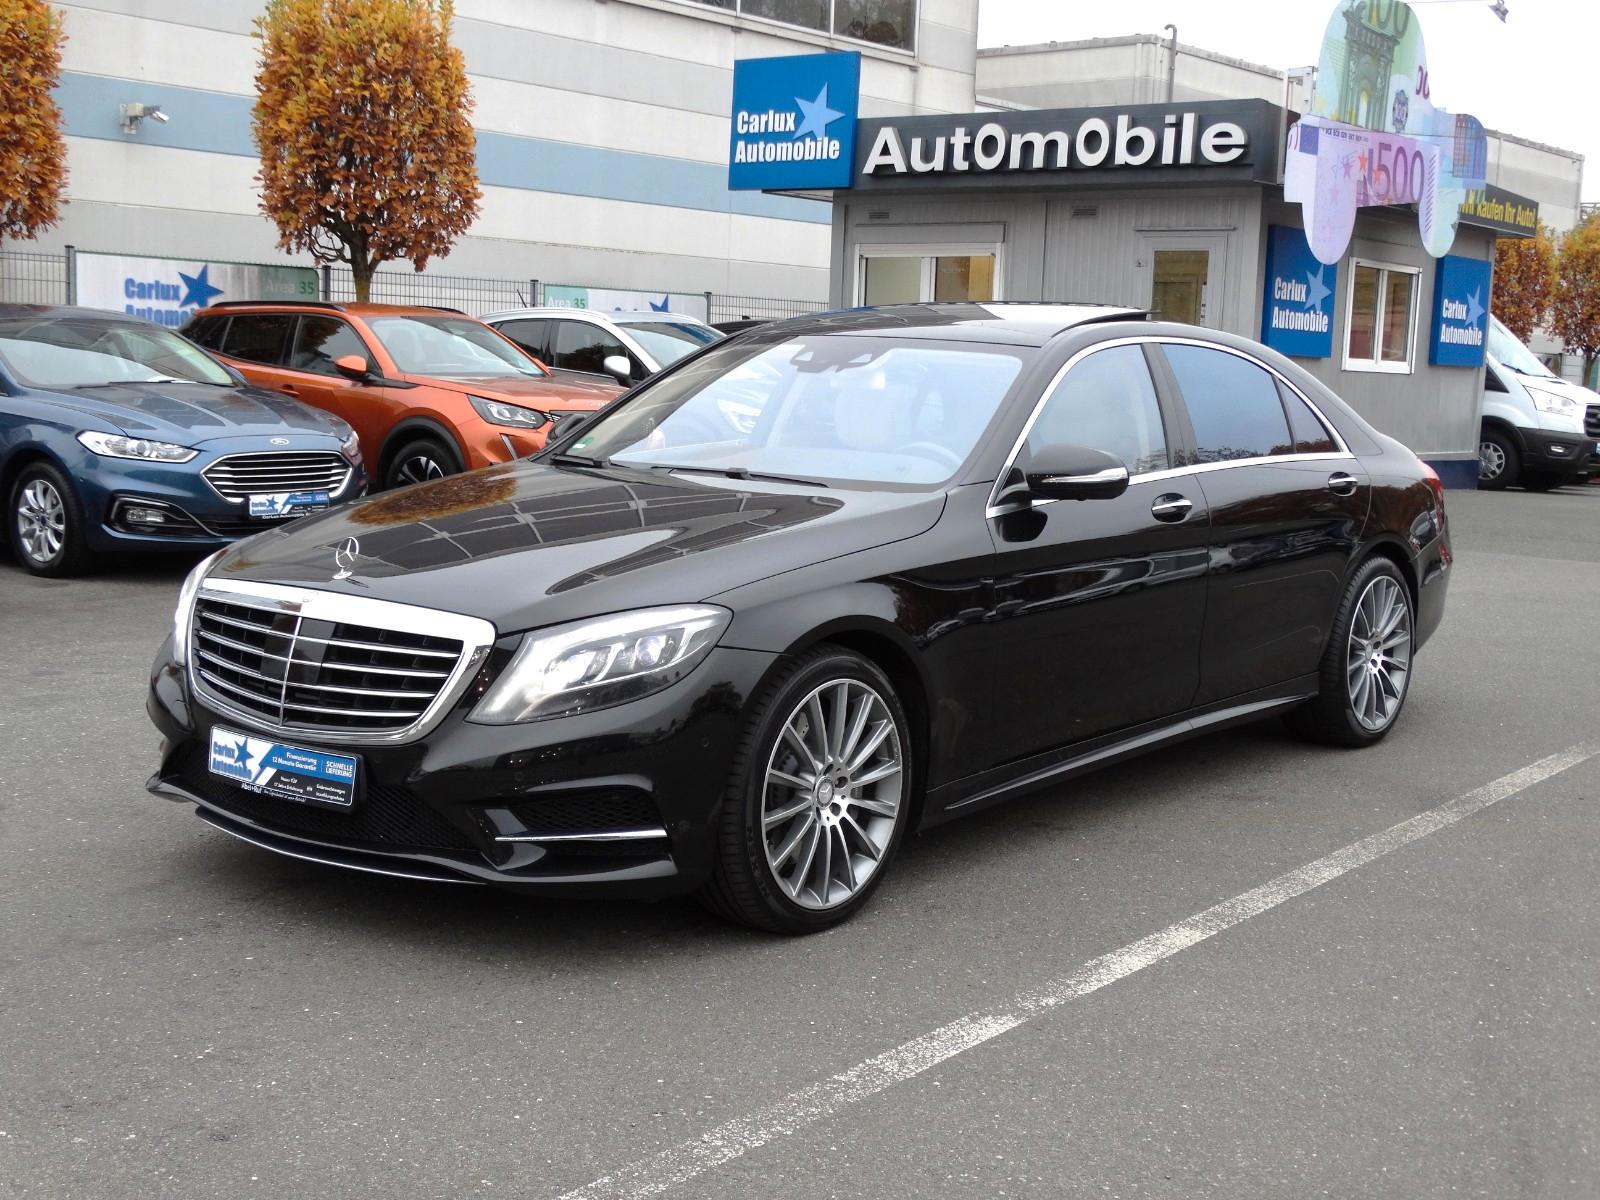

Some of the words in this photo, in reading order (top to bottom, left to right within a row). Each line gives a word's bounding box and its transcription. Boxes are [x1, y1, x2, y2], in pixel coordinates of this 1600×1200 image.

[737, 109, 796, 135] Carlux
[735, 138, 840, 164] Automobile
[1377, 143, 1425, 202] 500
[124, 278, 181, 301] Carlux
[266, 280, 295, 294] Area
[299, 281, 315, 295] 35
[1274, 276, 1307, 303] Carlux
[547, 296, 571, 308] Area
[573, 298, 586, 309] 35
[1442, 298, 1468, 321] Carlux
[1272, 306, 1329, 333] Automobile
[1440, 324, 1483, 346] Automobile
[325, 767, 353, 778] LIEFERUNG
[326, 760, 354, 772] SCHNELLE
